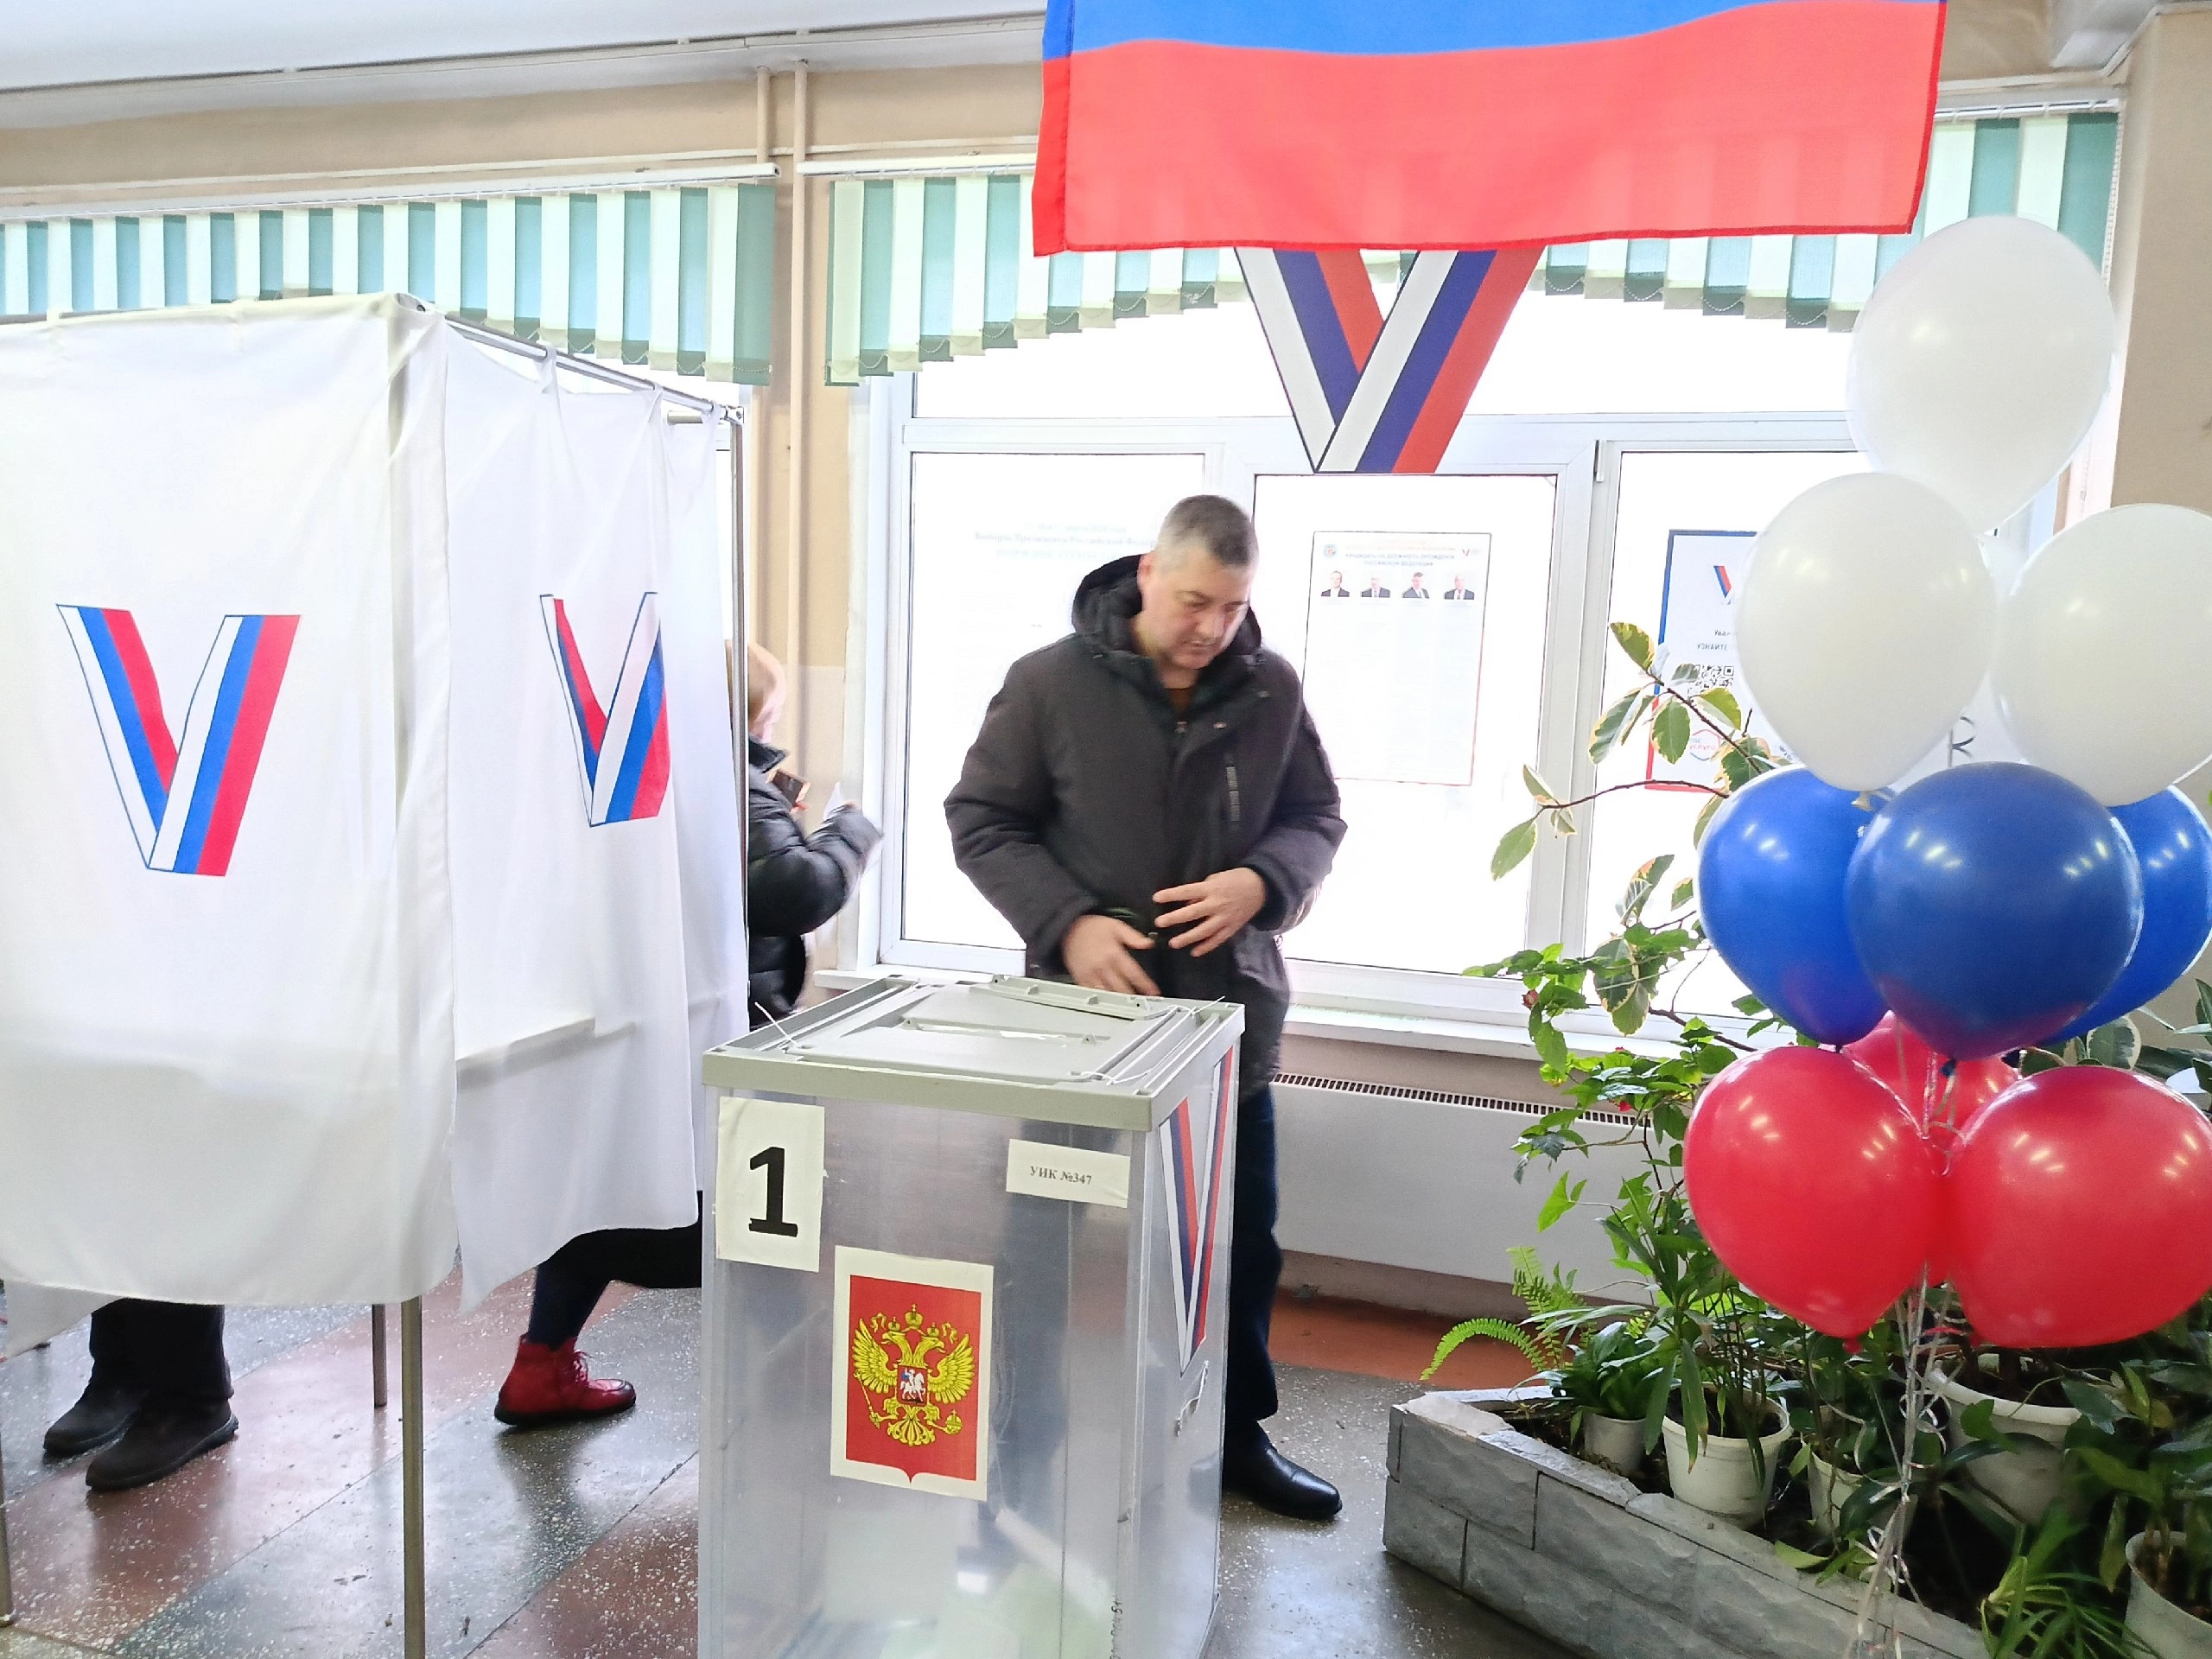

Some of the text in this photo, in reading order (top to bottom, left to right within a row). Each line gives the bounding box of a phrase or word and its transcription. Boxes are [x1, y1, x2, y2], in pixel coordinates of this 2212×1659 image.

[748, 1147, 798, 1237] 1
[1030, 1165, 1092, 1185] УИК №347
